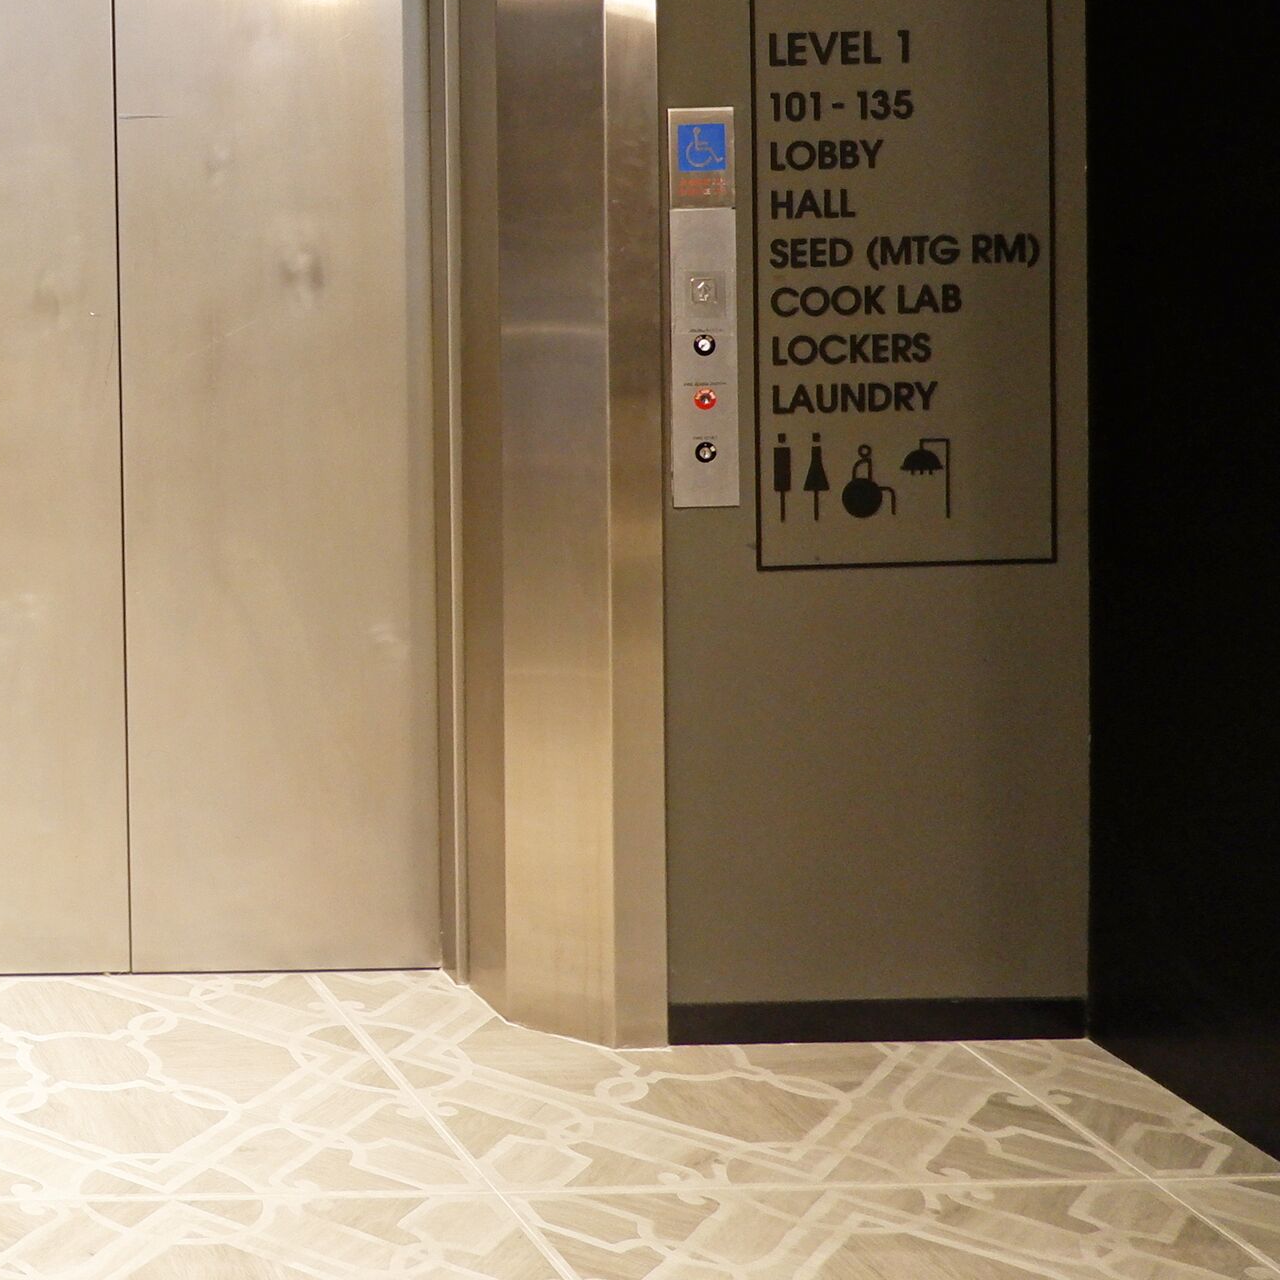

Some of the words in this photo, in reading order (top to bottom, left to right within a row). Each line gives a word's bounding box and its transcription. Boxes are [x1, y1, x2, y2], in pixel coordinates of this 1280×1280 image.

[769, 31, 881, 67] LEVEL
[897, 30, 909, 63] 1
[770, 92, 821, 122] 101
[857, 90, 914, 120] 135
[771, 139, 884, 171] LOBBY
[771, 189, 856, 219] HALL
[770, 237, 853, 268] SEED
[867, 234, 960, 271] (MTG
[971, 233, 1040, 267] RM)
[770, 285, 885, 317] COOK
[896, 283, 962, 314] LAB
[771, 333, 931, 367] LOCKERS
[770, 381, 938, 416] LAUNDRY
